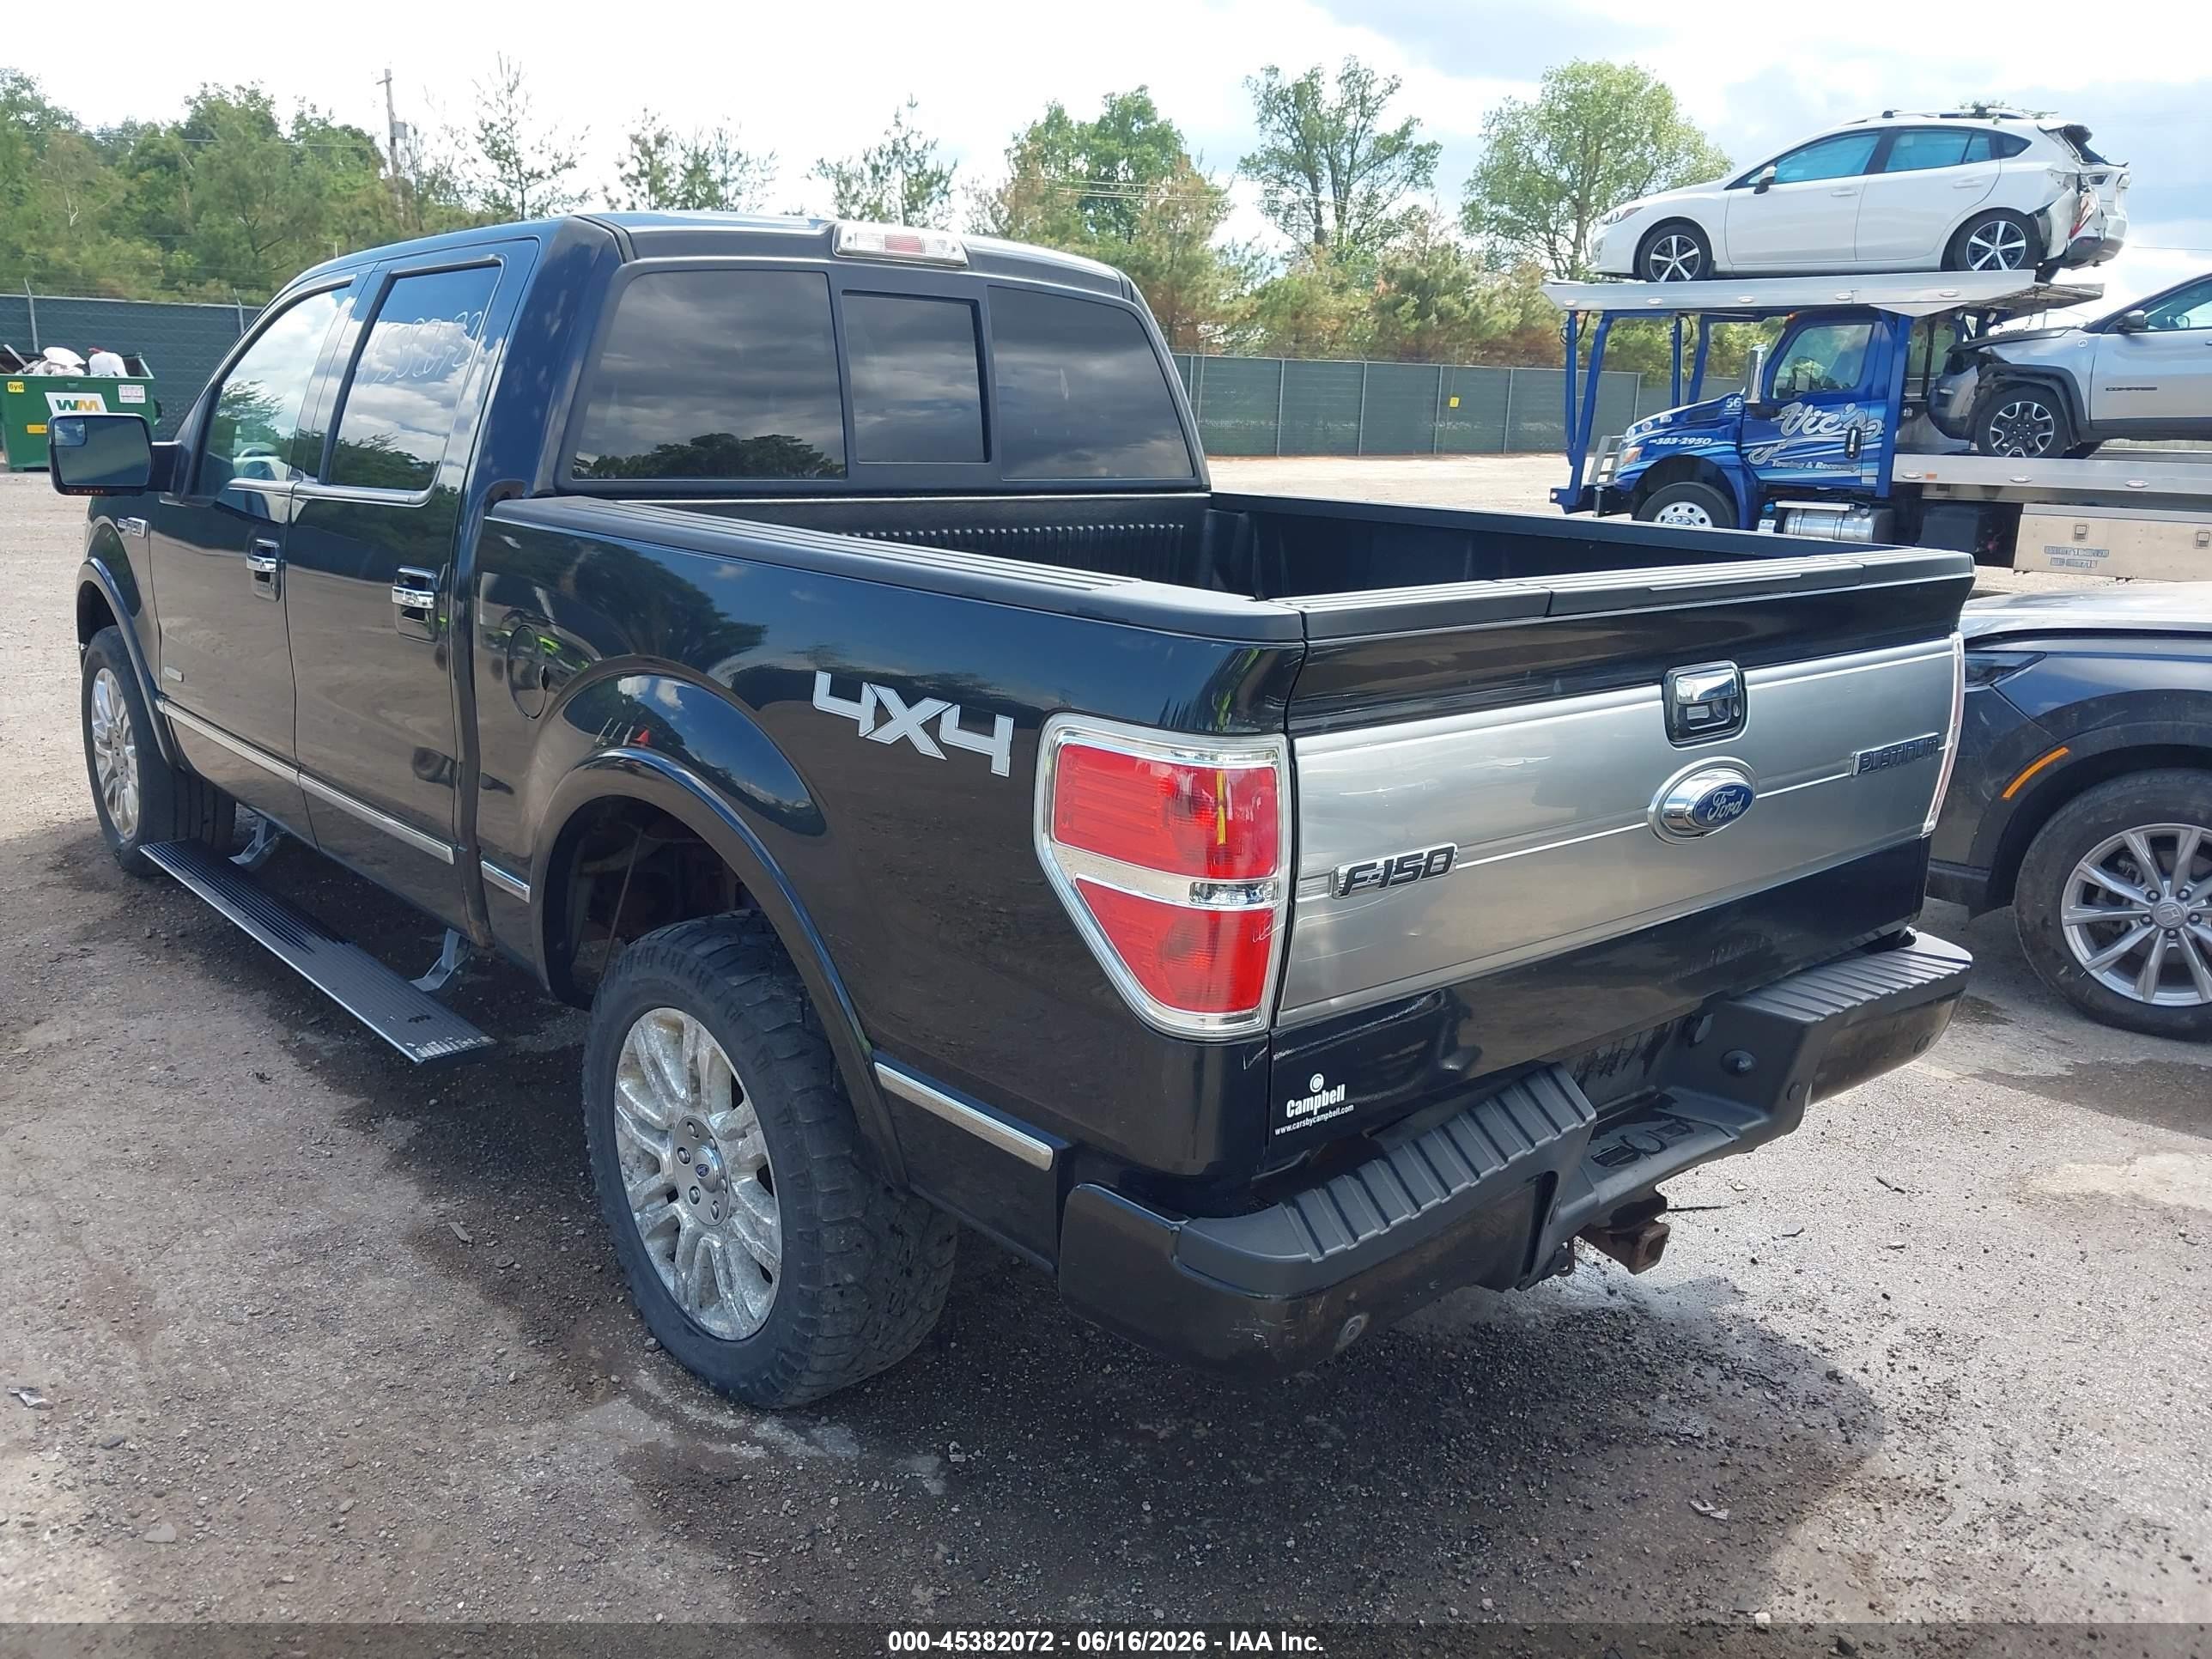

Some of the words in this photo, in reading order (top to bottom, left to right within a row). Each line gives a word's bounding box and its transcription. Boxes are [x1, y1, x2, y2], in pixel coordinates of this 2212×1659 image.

[55, 399, 100, 411] WM
[1725, 397, 1741, 409] 56
[1707, 789, 1745, 821] Ford
[1340, 846, 1456, 897] F-150
[1286, 1084, 1346, 1118] Campbell
[1274, 1104, 1354, 1136] www.carsbycampbell.com
